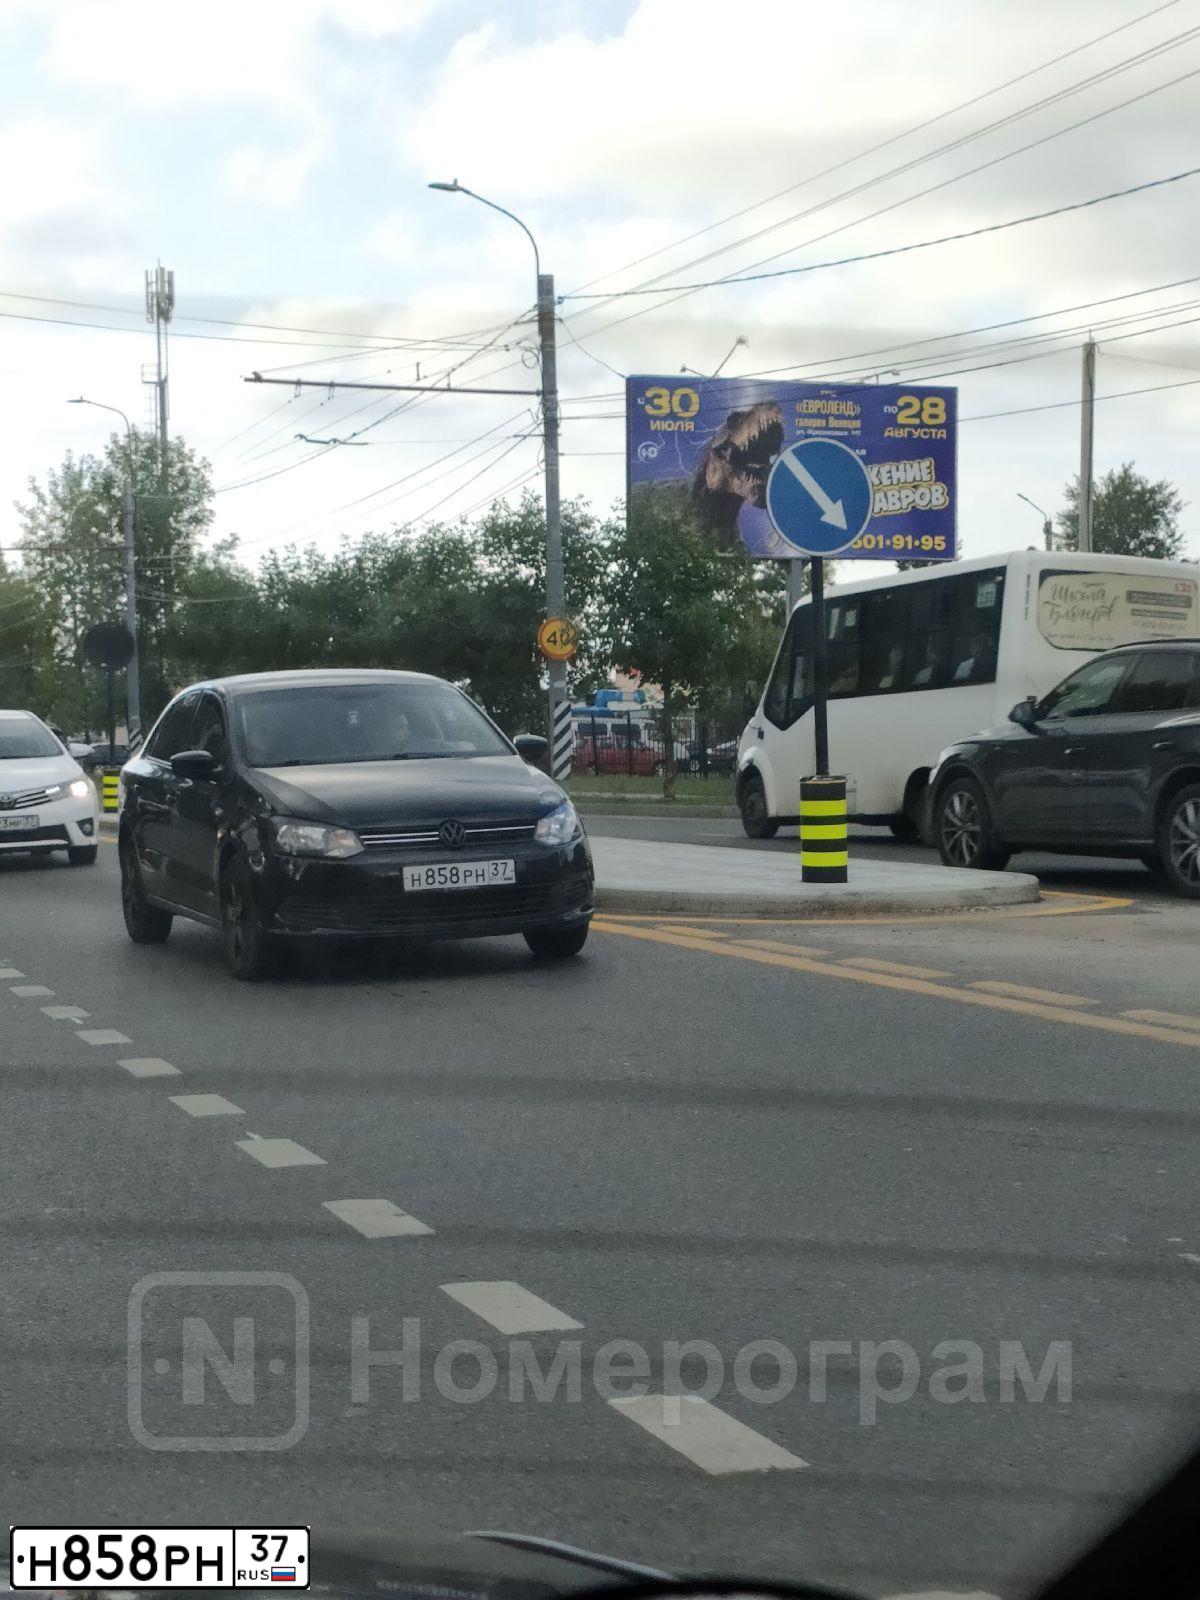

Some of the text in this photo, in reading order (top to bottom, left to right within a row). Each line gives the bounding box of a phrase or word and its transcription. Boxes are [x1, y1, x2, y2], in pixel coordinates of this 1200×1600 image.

[645, 387, 700, 418] 30
[897, 395, 947, 425] 28
[650, 419, 695, 432] ИЮЛЯ
[884, 426, 947, 440] АВГУСТА
[547, 630, 570, 646] 40
[411, 862, 508, 887] Н858РН 37
